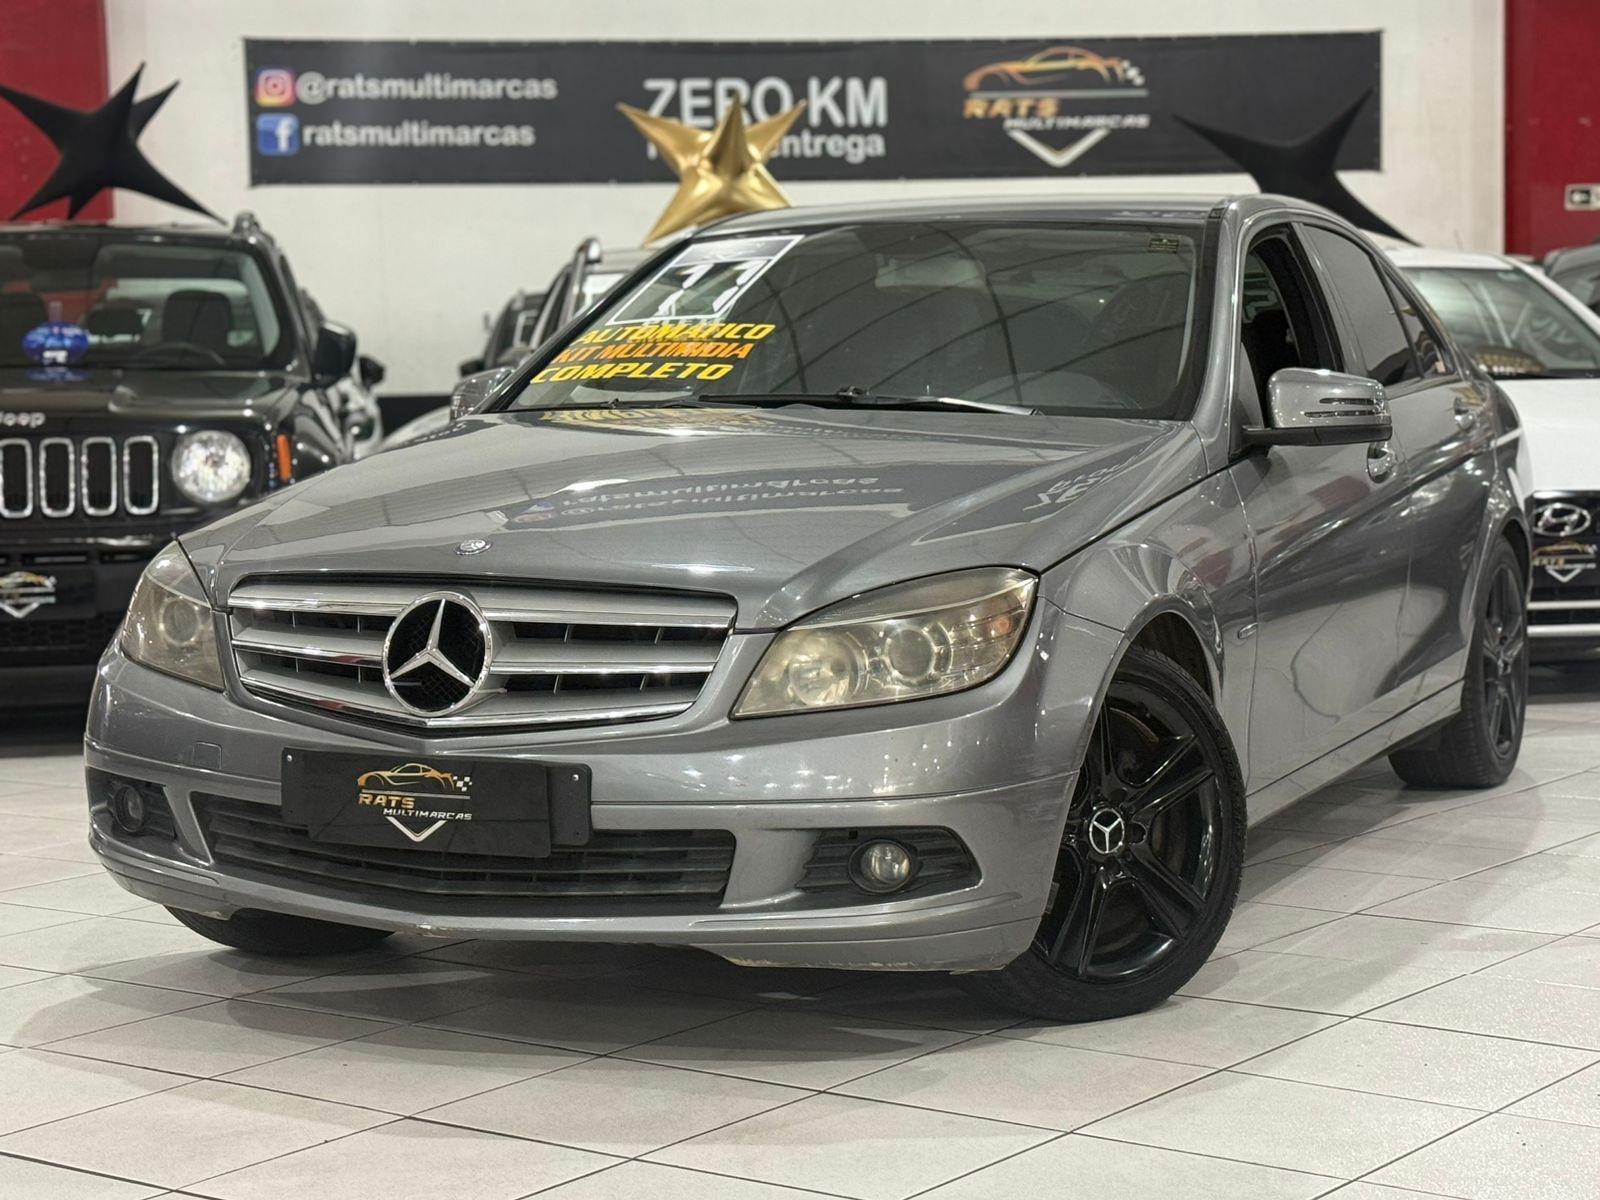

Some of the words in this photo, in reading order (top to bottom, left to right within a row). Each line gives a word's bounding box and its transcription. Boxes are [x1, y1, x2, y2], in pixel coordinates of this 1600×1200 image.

[296, 71, 558, 104] @ratsmultimarcas
[643, 76, 794, 128] ZERO
[807, 76, 887, 128] KM
[963, 98, 1059, 118] RATS
[303, 120, 536, 146] ratsmultimarcas
[771, 129, 886, 163] ntrega
[530, 363, 734, 384] COMPLETO
[358, 793, 416, 809] RATS
[382, 808, 473, 821] MULTIMARCAS
